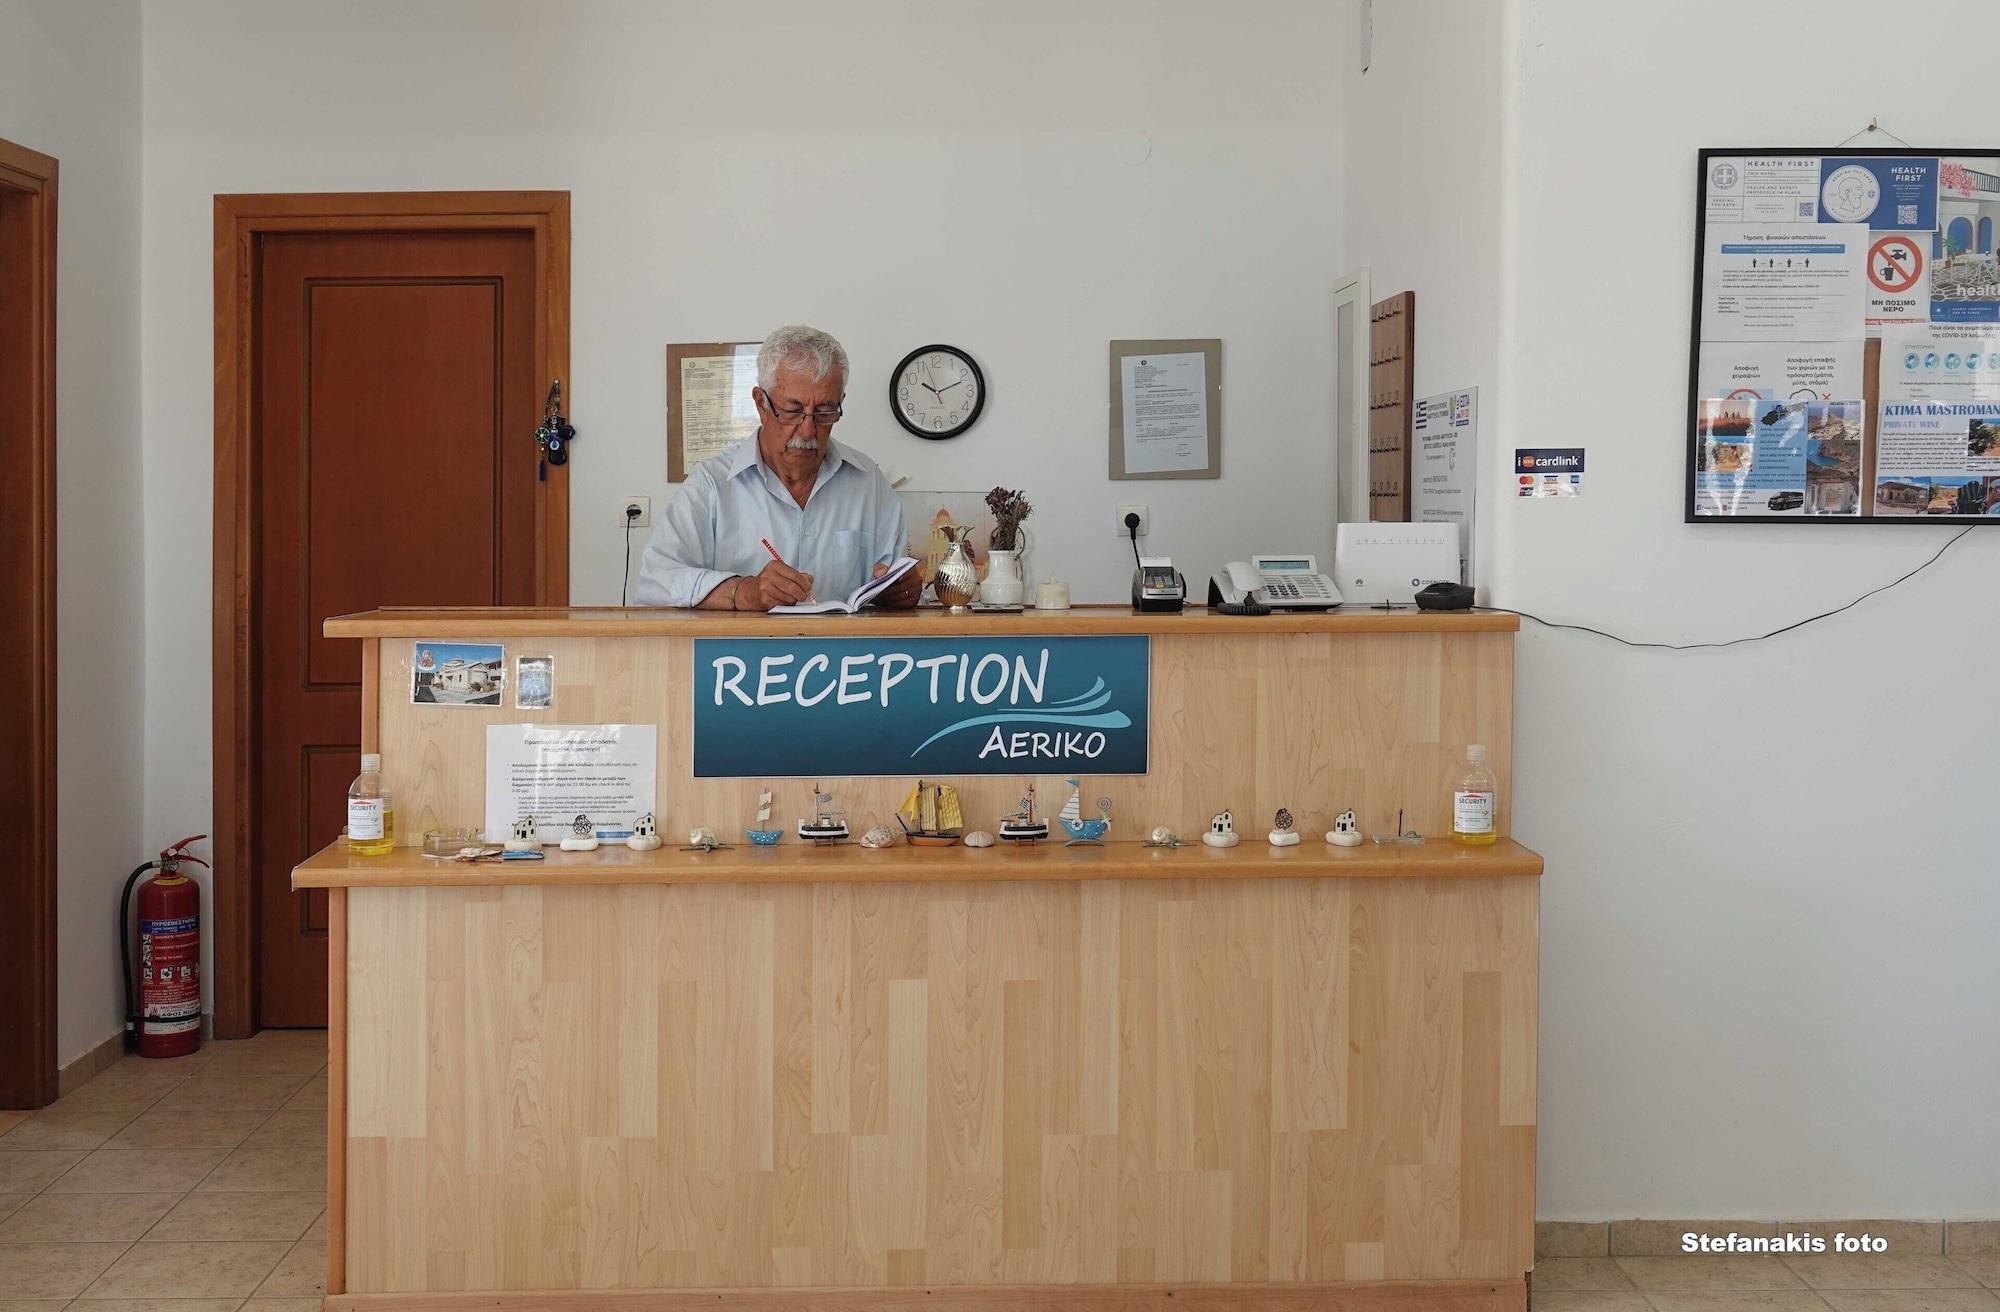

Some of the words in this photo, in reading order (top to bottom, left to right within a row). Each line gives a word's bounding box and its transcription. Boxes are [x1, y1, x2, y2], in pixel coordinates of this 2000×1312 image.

[916, 361, 925, 374] 11
[929, 355, 942, 368] 12
[950, 358, 953, 370] 1
[906, 372, 917, 385] 10
[960, 368, 968, 381] 2
[900, 387, 908, 400] 9
[966, 384, 974, 398] 3
[907, 403, 915, 416] 8
[962, 401, 969, 413] 4
[1885, 405, 1922, 416] KTIMA
[1927, 405, 2000, 416] MASTROMAN
[919, 413, 926, 425] 7
[934, 416, 942, 429] 6
[950, 411, 958, 424] 5
[1535, 456, 1578, 466] cardlink
[713, 649, 1049, 707] RECEPTION
[979, 725, 1106, 759] AERIKO
